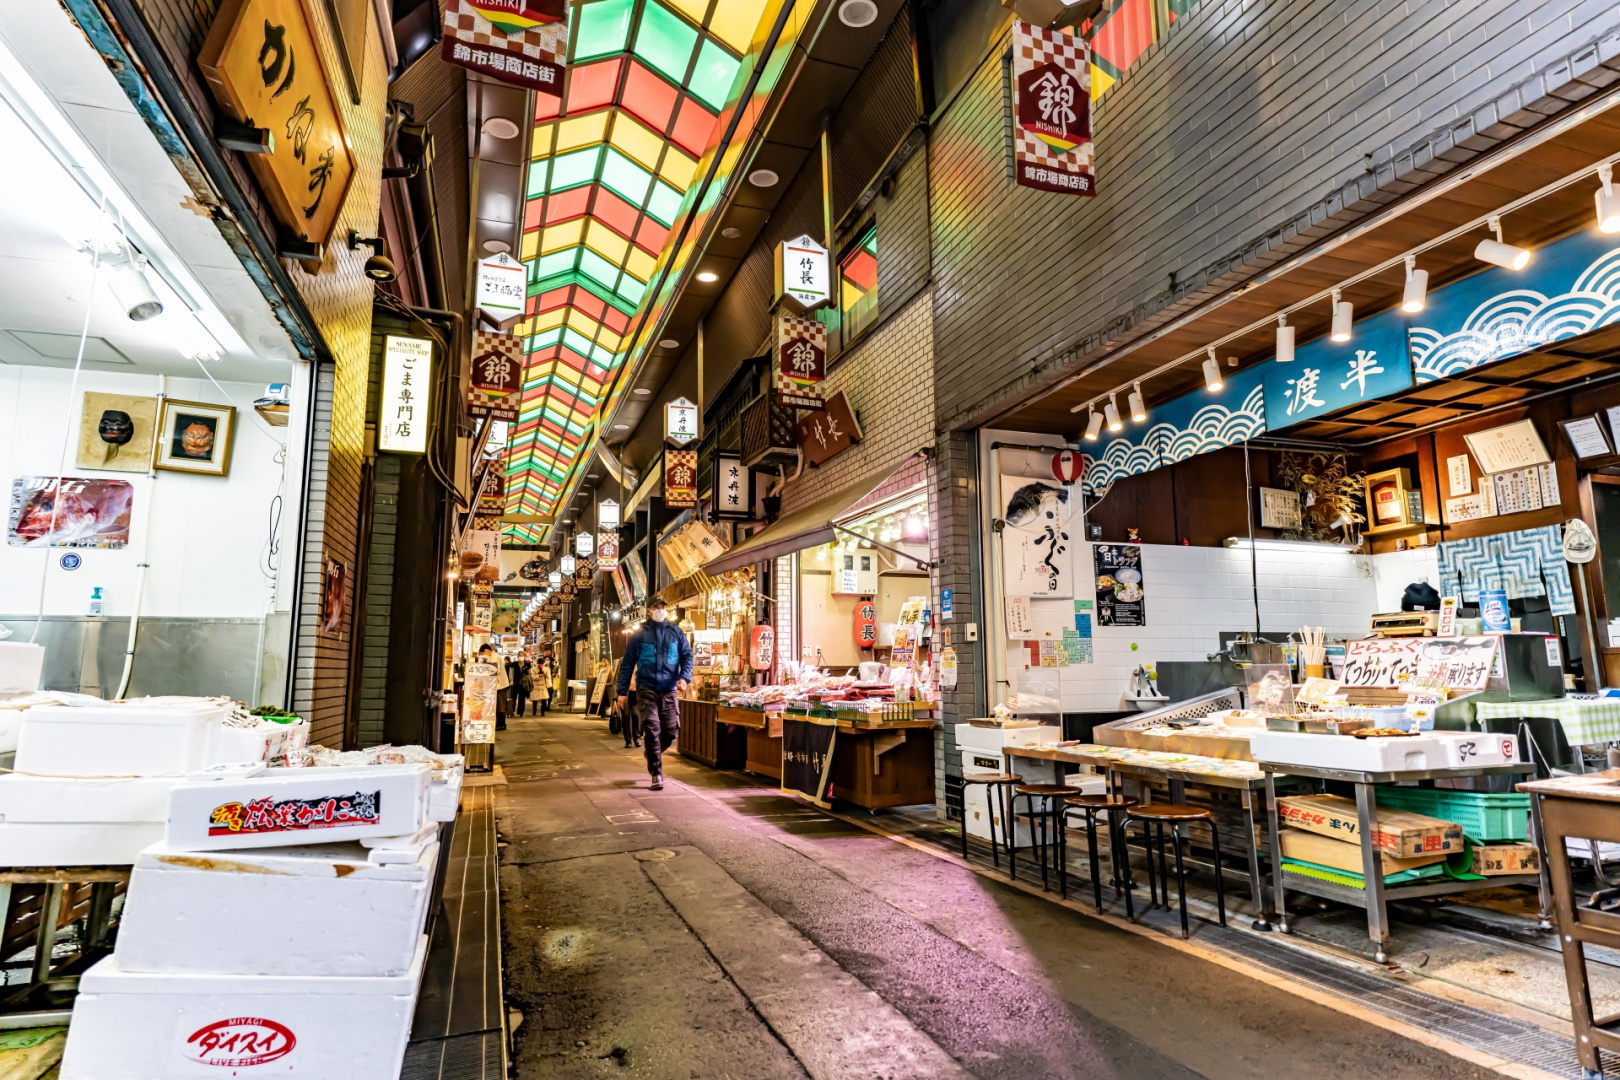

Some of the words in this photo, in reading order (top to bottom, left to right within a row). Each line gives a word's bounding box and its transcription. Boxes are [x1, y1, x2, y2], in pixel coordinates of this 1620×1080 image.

[453, 43, 556, 85] 錦市場商店街
[1028, 71, 1077, 139] 錦
[1035, 119, 1064, 136] NISHIKI
[1024, 166, 1089, 191] 錦市場商店街
[800, 257, 814, 285] 竹長
[395, 341, 422, 349] SESAME
[478, 355, 512, 391] 錦
[787, 342, 816, 379] 錦
[1284, 349, 1385, 416] 渡半
[395, 358, 417, 438] ごま専門店
[472, 406, 515, 419] 錦市商店街
[678, 408, 687, 433] 京丹波
[670, 465, 692, 489] 錦
[727, 466, 740, 506] 京丹波
[860, 604, 876, 641] 竹長
[758, 630, 773, 665] 竹長
[1350, 639, 1423, 655] とらふぐ
[1329, 817, 1361, 834] んま
[228, 1018, 263, 1027] MIYAGI
[199, 1030, 278, 1058] ダイスイ
[209, 1057, 235, 1067] LIVE
[239, 1056, 265, 1067] FISH
